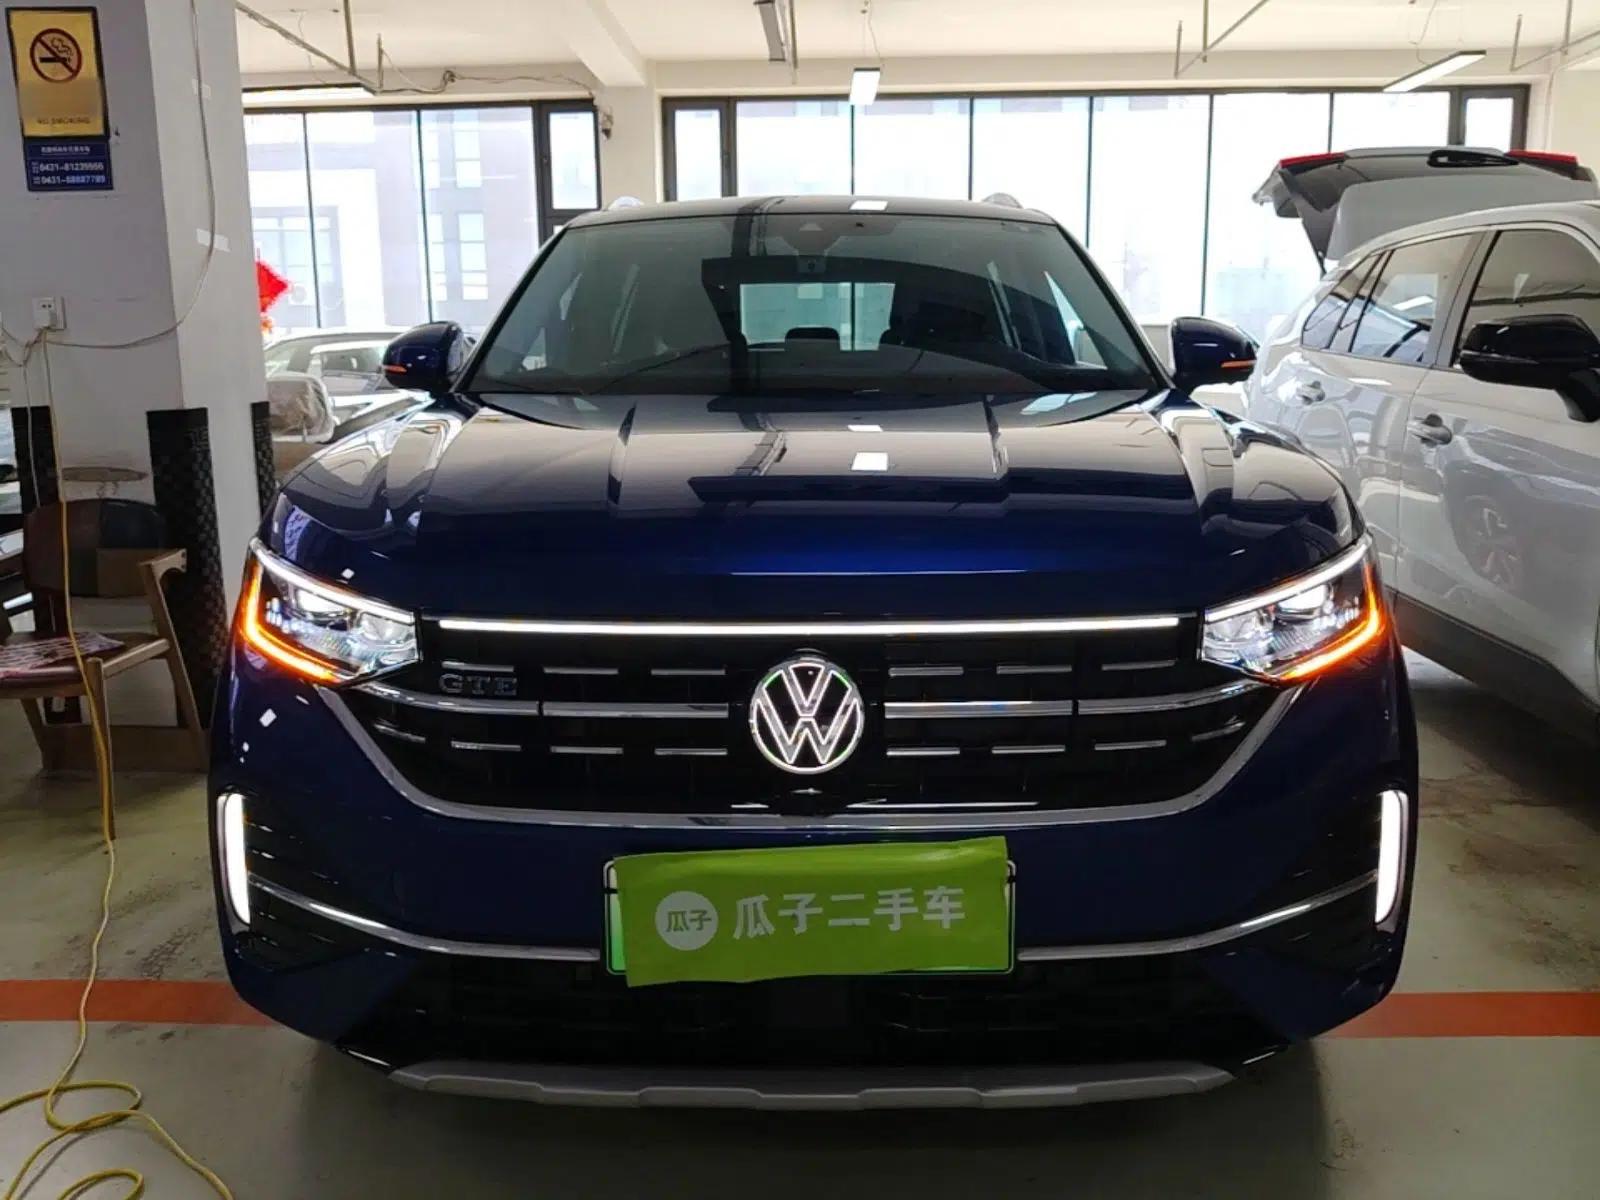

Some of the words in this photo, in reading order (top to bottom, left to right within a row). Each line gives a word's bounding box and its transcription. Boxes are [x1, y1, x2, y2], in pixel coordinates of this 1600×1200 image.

[439, 673, 517, 696] GTE
[665, 909, 712, 933] 瓜子
[733, 885, 966, 940] 瓜子二手车
